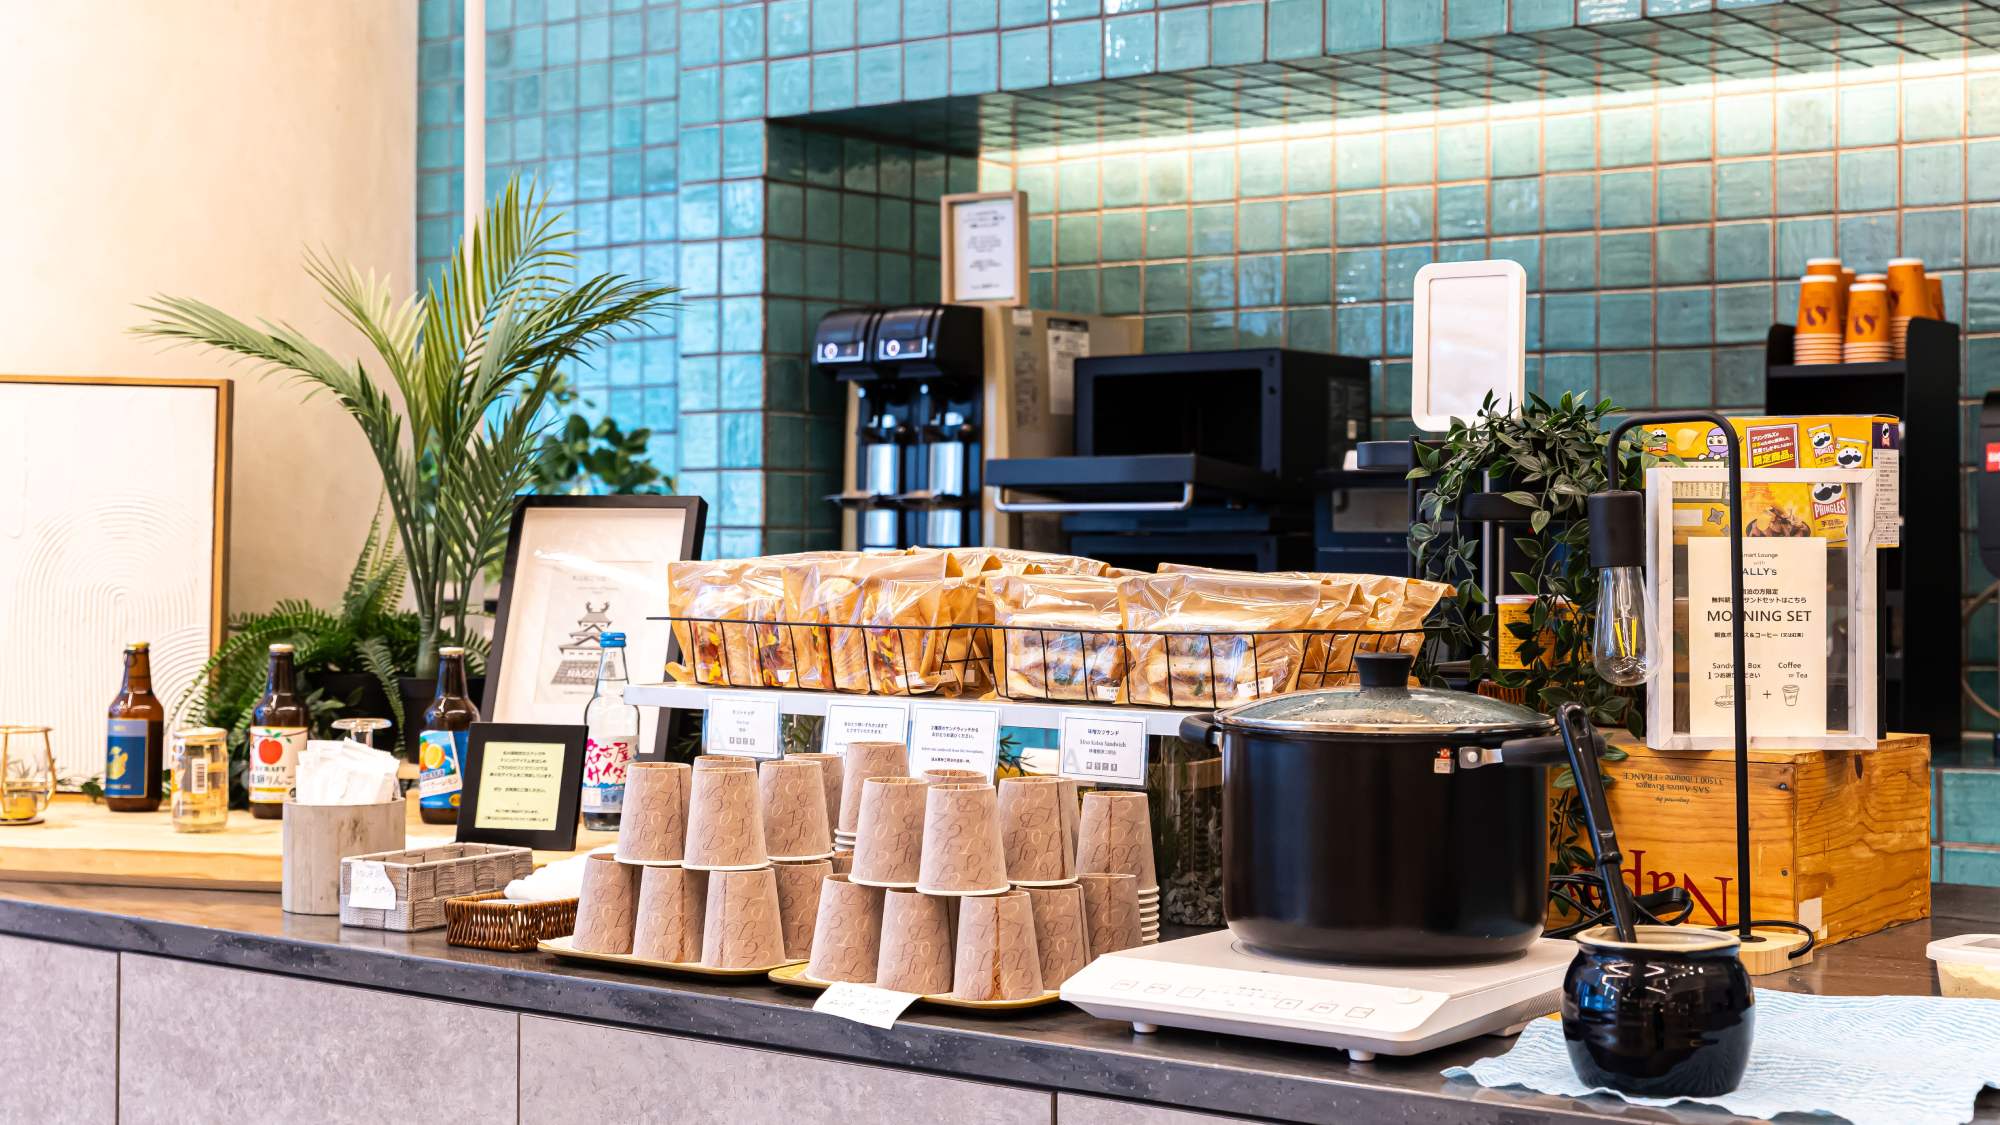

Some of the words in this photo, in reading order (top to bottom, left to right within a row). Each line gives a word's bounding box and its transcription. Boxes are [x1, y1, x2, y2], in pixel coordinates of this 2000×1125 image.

[1814, 498, 1847, 519] PRINGLES
[1743, 567, 1778, 576] ALLY's
[1707, 610, 1782, 622] MONING
[1786, 610, 1812, 622] SET
[1623, 772, 1657, 781] FRANCE
